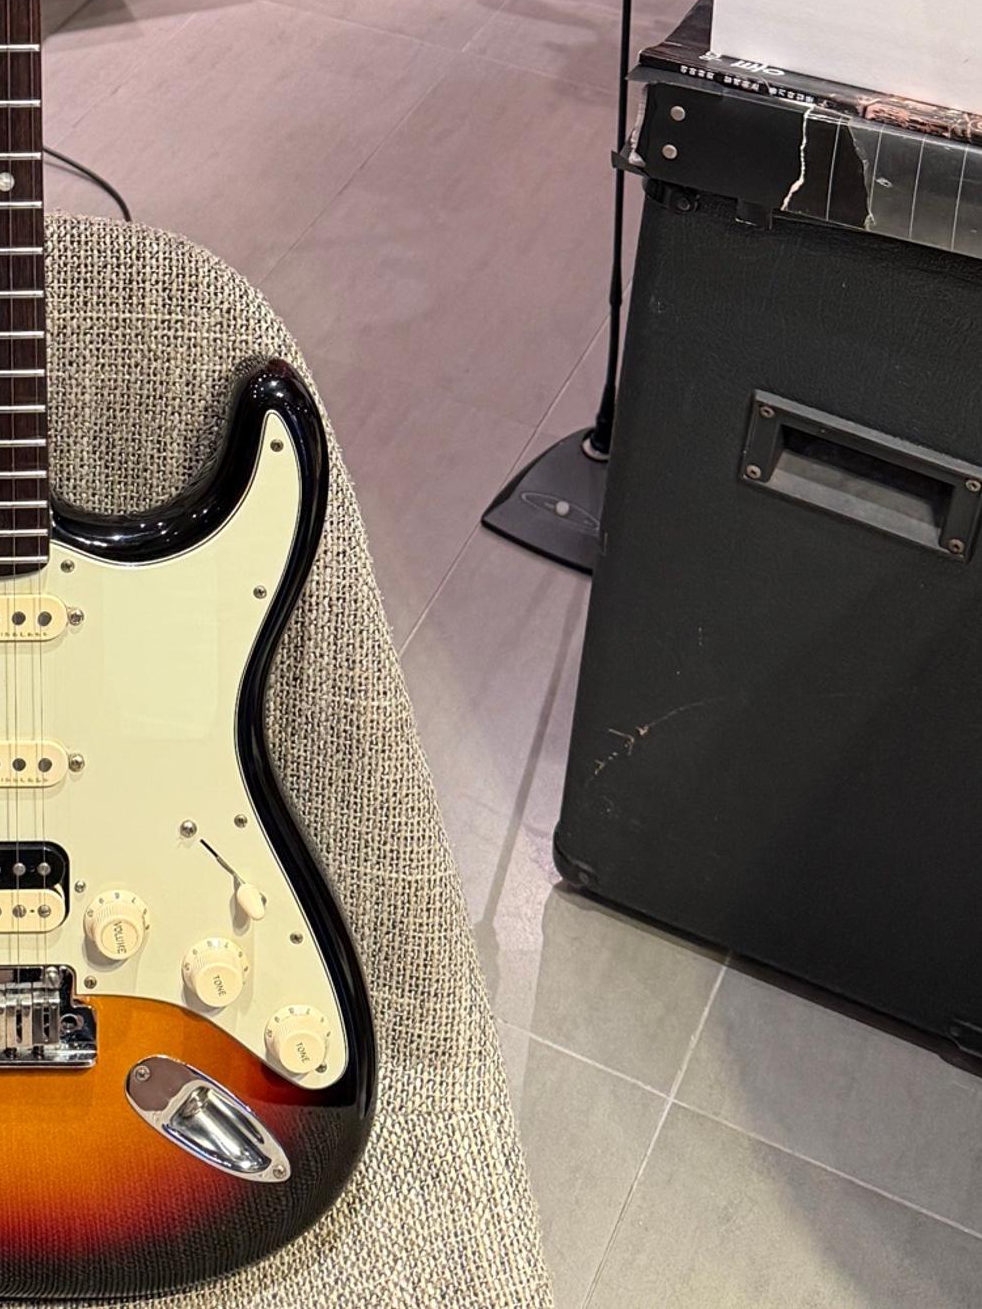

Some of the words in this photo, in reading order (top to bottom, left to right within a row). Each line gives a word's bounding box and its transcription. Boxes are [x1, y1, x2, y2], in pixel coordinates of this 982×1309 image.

[113, 920, 128, 955] VOLUME
[212, 974, 227, 997] TONE
[296, 1042, 310, 1063] TONE
